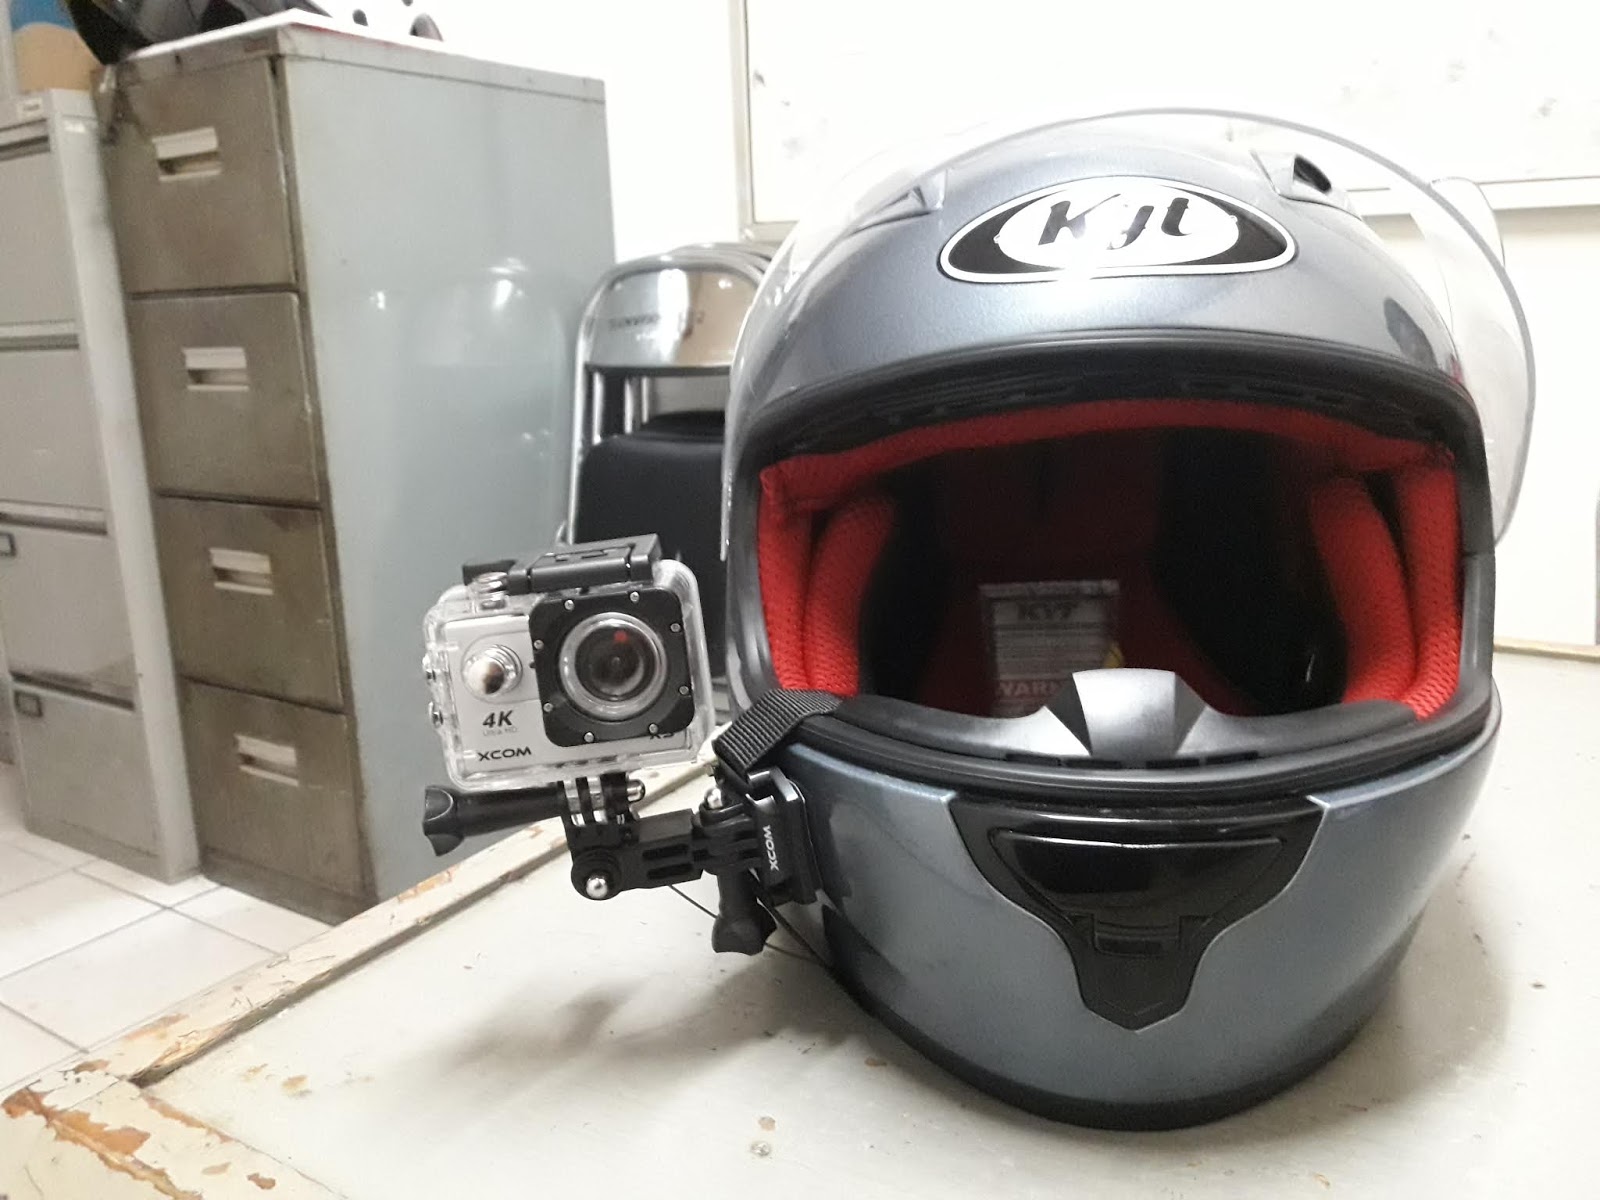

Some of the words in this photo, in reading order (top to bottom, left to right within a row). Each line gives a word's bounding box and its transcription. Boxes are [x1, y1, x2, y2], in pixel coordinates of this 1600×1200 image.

[482, 710, 513, 728] 4K
[478, 746, 532, 761] XCOM
[763, 825, 780, 871] XCOM
